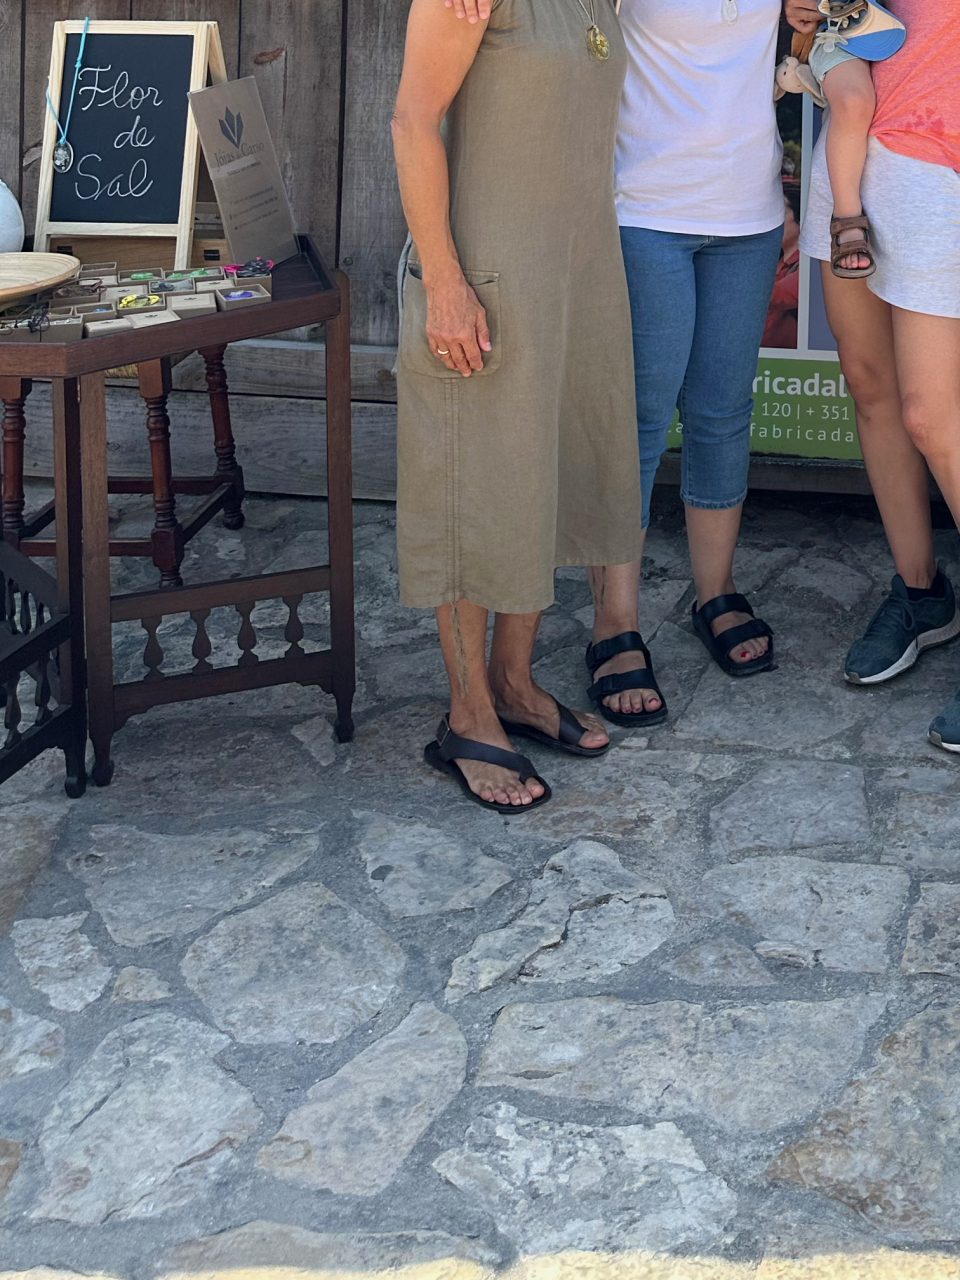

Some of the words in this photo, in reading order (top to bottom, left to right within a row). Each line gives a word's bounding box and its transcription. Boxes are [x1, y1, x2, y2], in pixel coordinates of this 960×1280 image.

[78, 64, 164, 111] Flor
[114, 115, 156, 149] de
[75, 153, 154, 201] Sal
[752, 370, 848, 398] ricadal
[761, 402, 791, 418] 120
[821, 405, 849, 420] 351
[750, 423, 854, 442] fabricada
